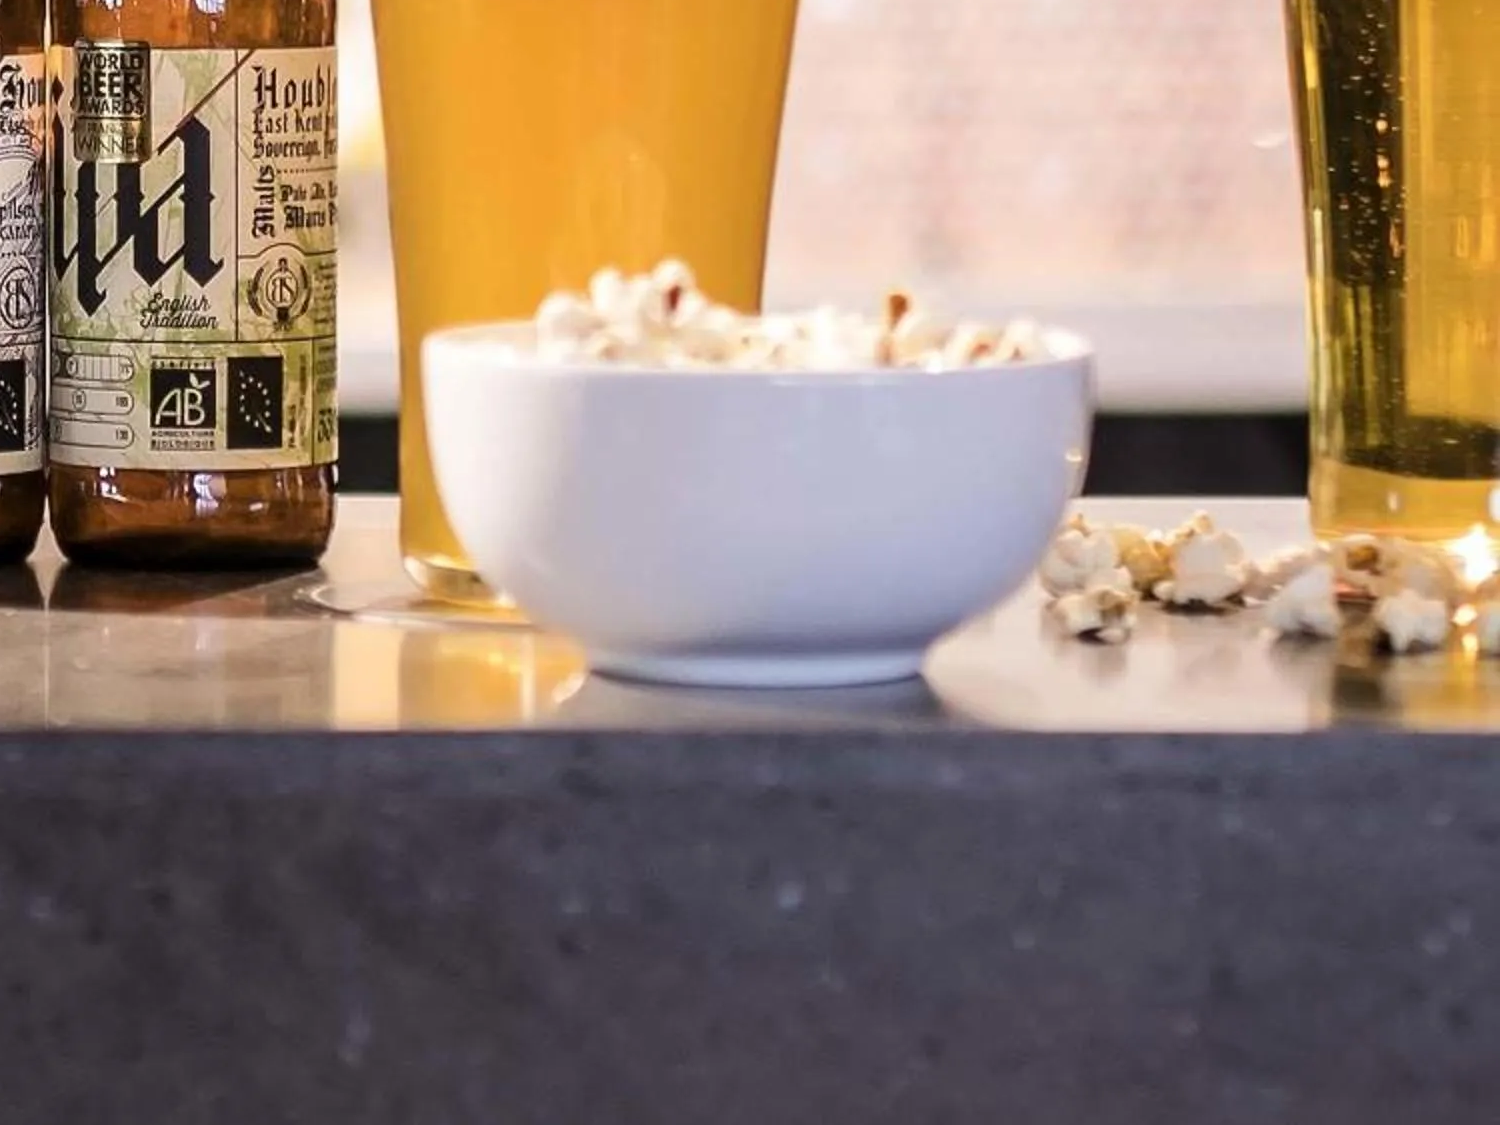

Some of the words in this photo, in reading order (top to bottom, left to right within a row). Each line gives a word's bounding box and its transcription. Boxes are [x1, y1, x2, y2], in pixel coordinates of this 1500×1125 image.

[79, 53, 143, 70] WORLD
[79, 72, 143, 97] BEER
[78, 98, 145, 114] AWARDS
[148, 293, 211, 314] English
[141, 308, 219, 328] Tradition
[155, 388, 205, 425] AB
